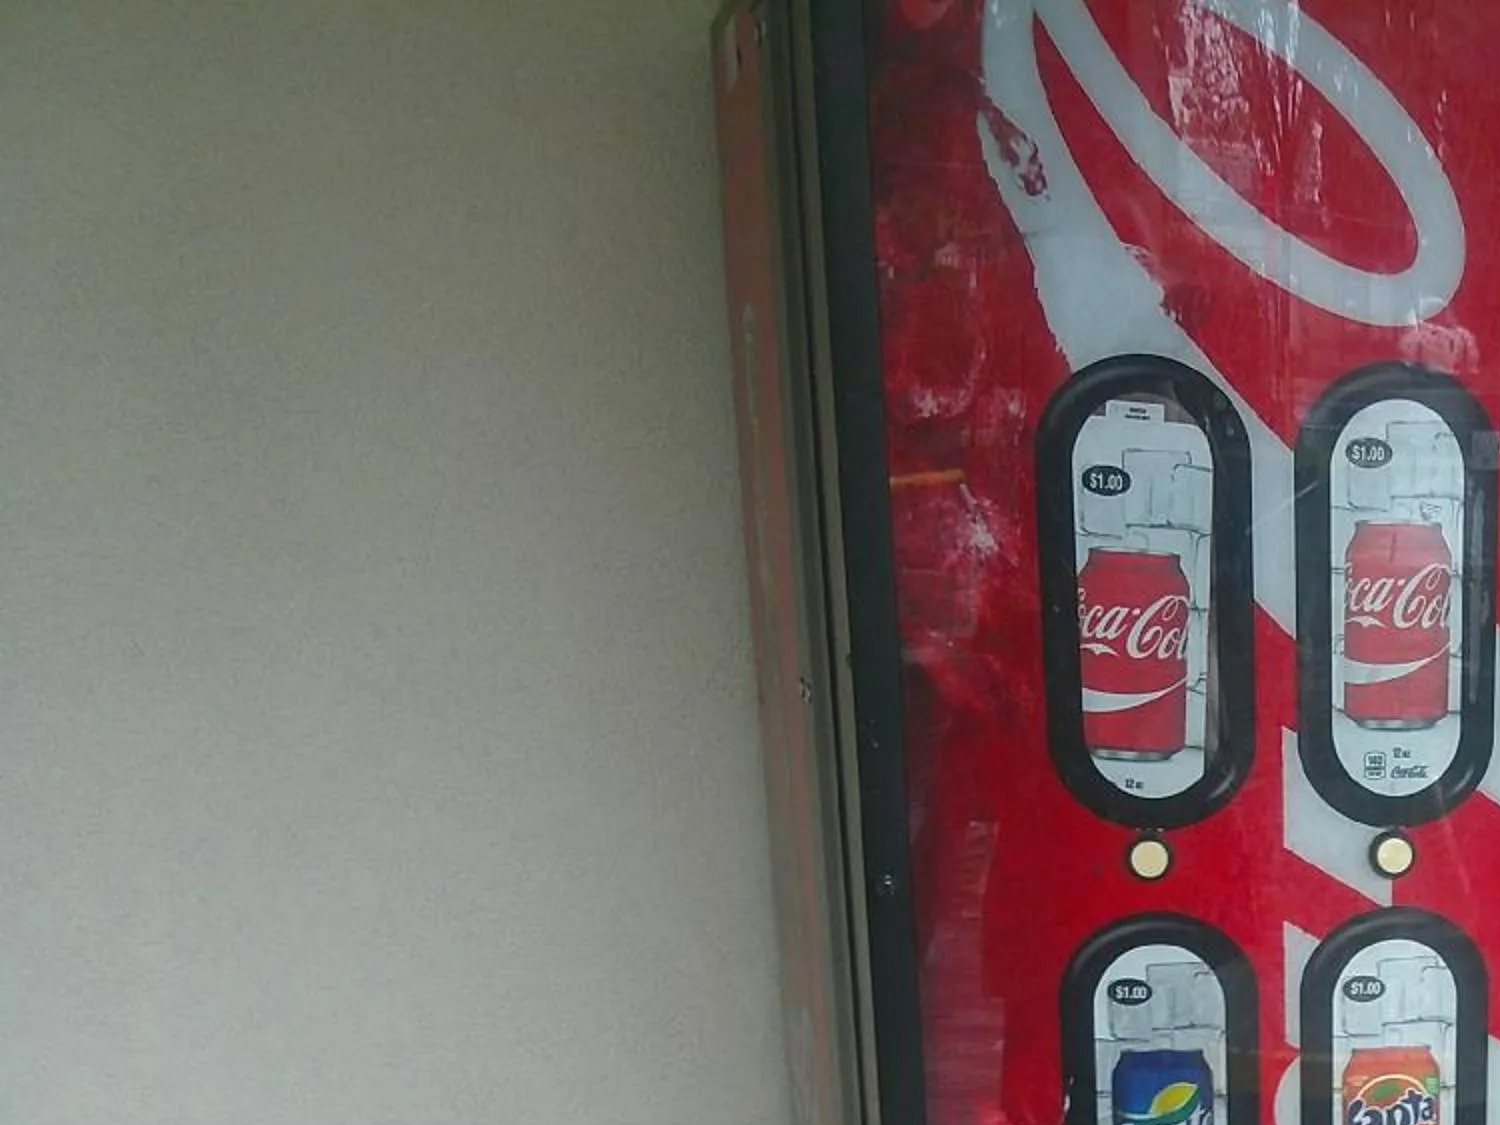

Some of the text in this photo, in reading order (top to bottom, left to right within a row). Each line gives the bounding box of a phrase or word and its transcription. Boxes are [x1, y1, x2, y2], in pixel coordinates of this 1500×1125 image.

[1352, 444, 1385, 461] $1.00
[1089, 473, 1123, 491] $1.00
[1116, 986, 1148, 1000] $1.00
[1350, 981, 1381, 995] $1.00
